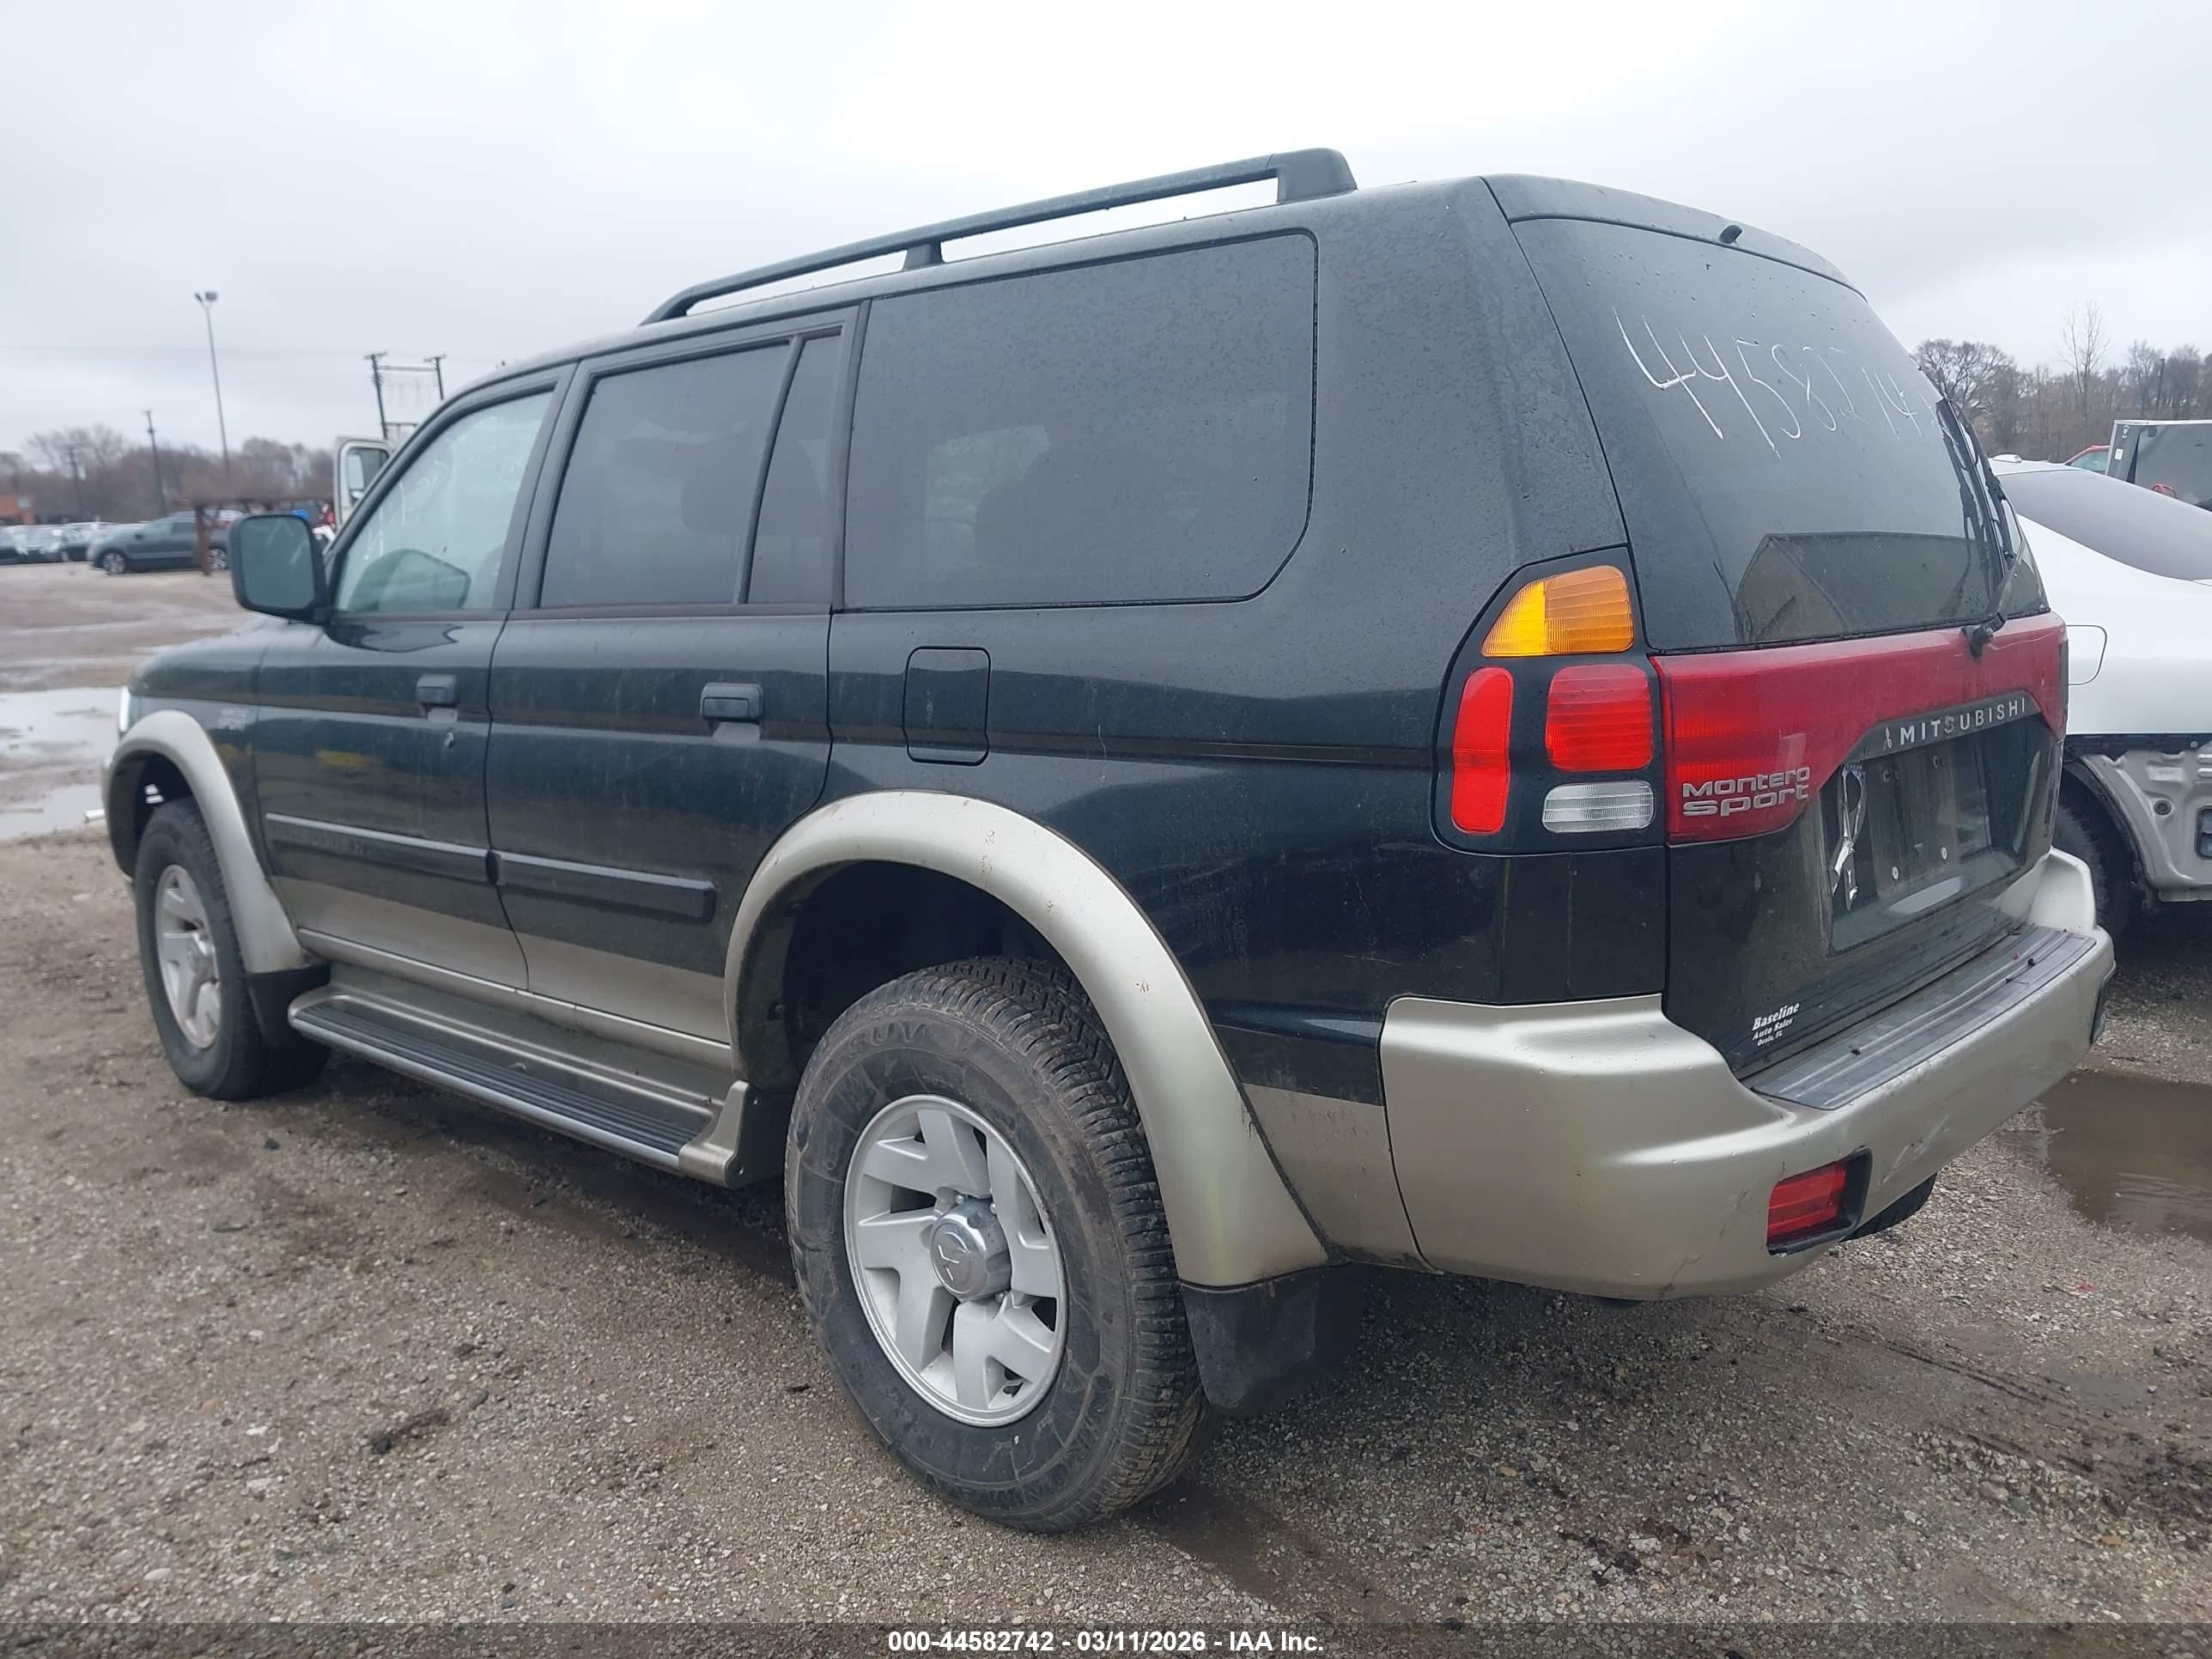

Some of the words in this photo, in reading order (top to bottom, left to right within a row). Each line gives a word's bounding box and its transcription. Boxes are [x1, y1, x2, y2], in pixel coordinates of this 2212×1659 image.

[1899, 696, 2027, 745] MITSUBISHI
[1682, 766, 1811, 798] Montero
[1752, 1003, 1800, 1030] Baseline
[1752, 1027, 1772, 1041] Auto
[1773, 1018, 1793, 1031] Sales
